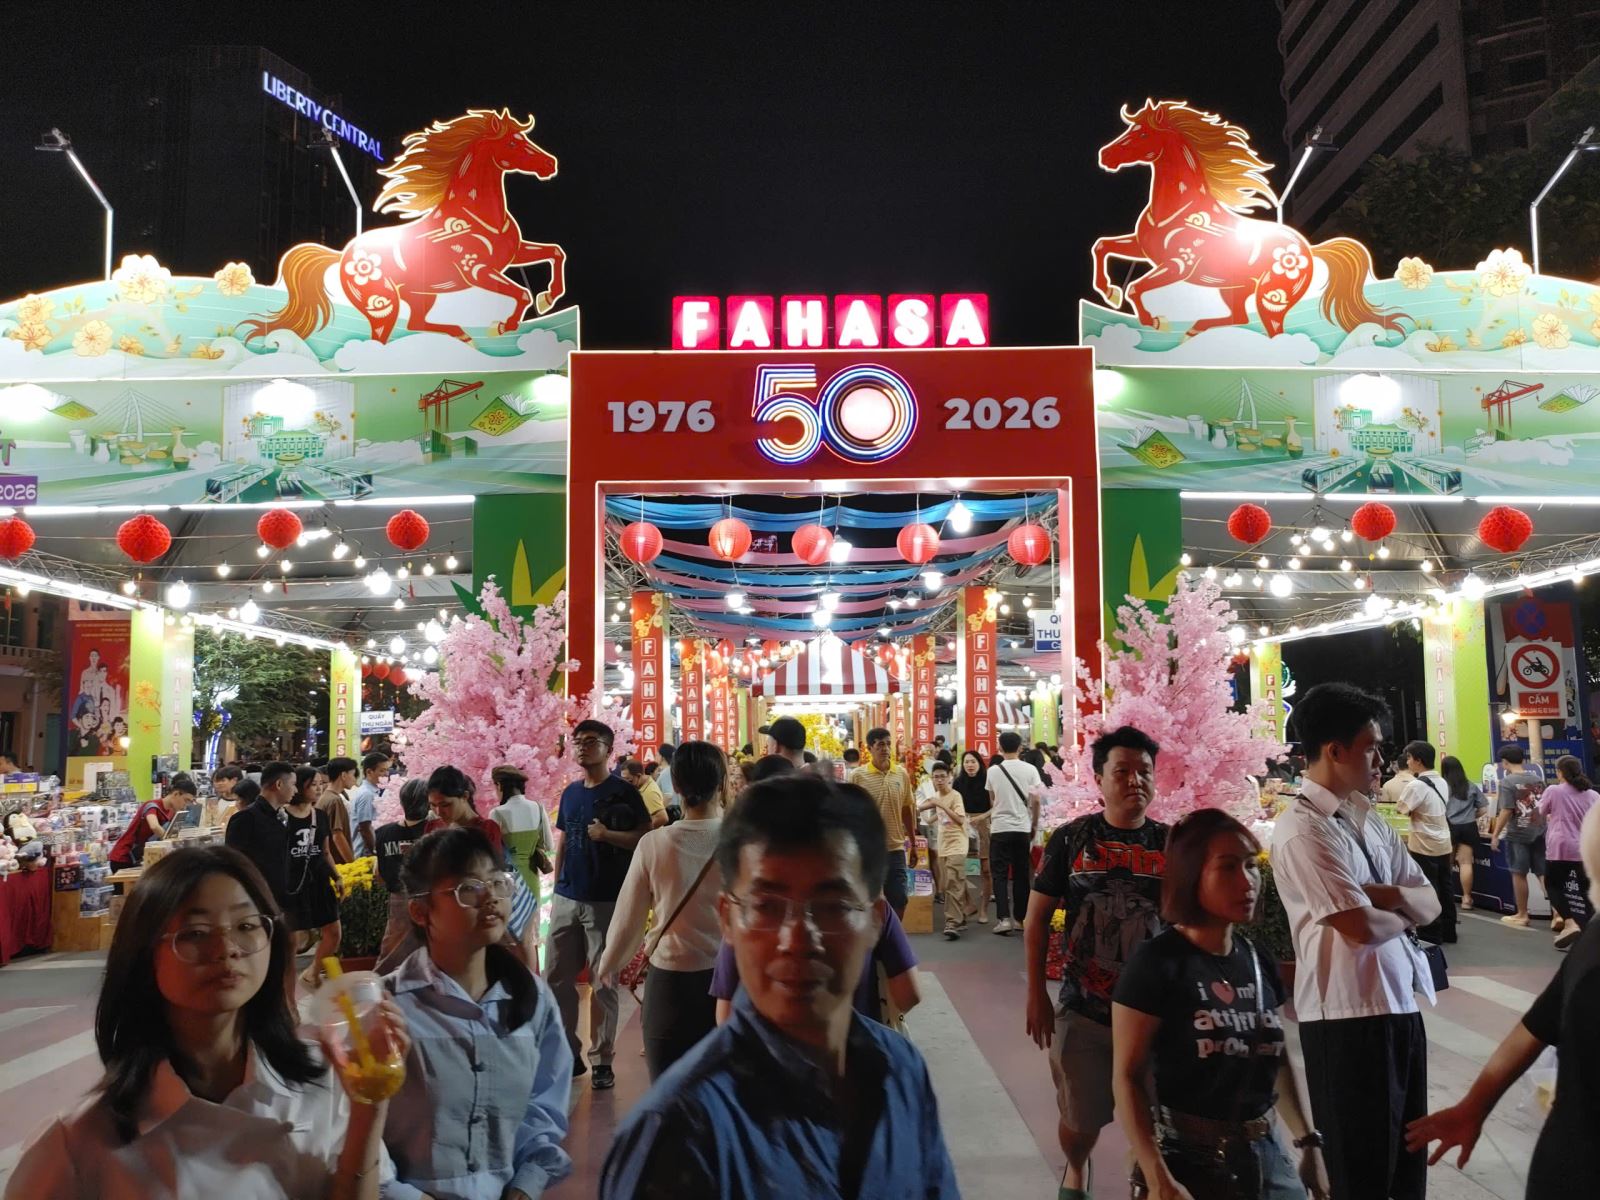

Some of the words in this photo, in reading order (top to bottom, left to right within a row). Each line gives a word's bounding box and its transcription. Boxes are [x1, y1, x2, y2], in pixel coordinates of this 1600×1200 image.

[263, 71, 321, 121] LIBERTY
[322, 108, 384, 161] CENTRAL
[681, 298, 988, 348] FAHASA
[607, 400, 716, 433] 1976
[751, 362, 919, 466] 50
[944, 396, 1061, 430] 2026
[1037, 629, 1061, 639] THU
[337, 683, 346, 756] FAHAS
[642, 639, 657, 763] FAHASA
[687, 672, 698, 741] FAHAS
[715, 688, 724, 744] FAHAS
[918, 668, 929, 741] FAHAS
[974, 634, 990, 757] FAHASA
